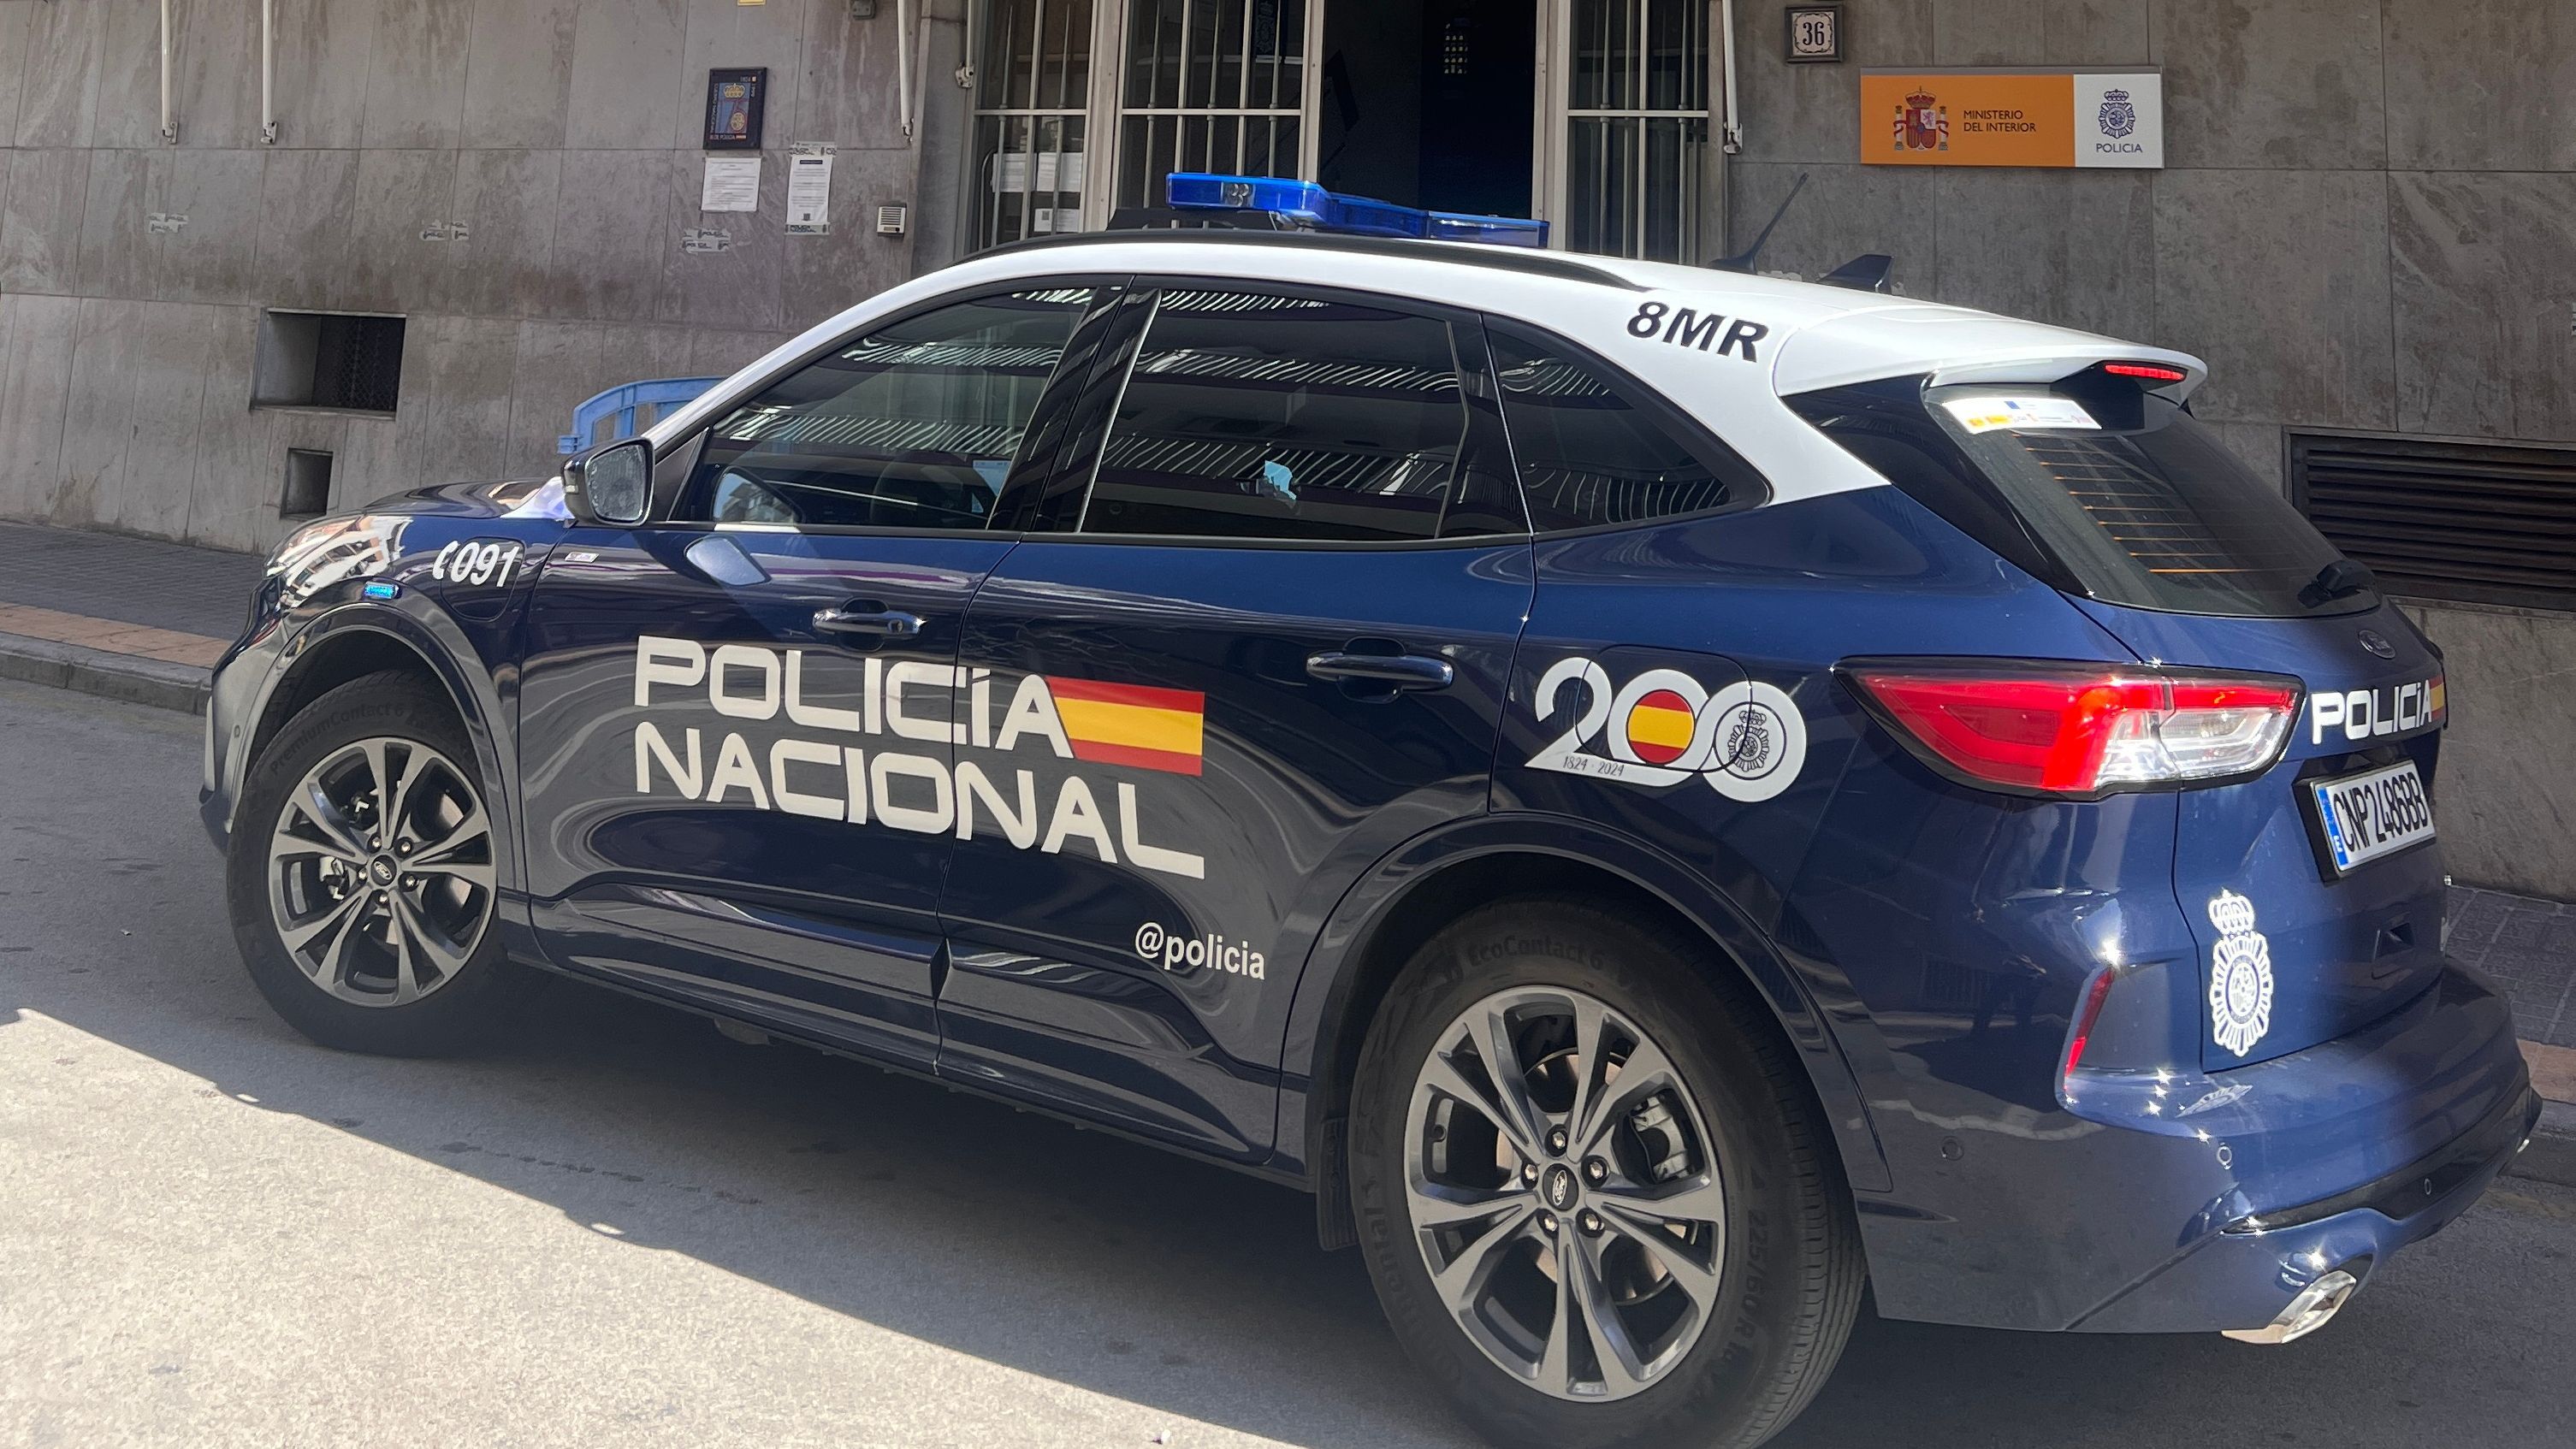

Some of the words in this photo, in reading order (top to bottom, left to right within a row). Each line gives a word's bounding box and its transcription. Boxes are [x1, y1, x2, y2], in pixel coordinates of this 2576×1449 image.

[1803, 21, 1824, 45] 36
[1963, 109, 2023, 120] MINISTERIO
[1963, 121, 1983, 132] DEL
[1986, 121, 2036, 133] INTERIOR
[2096, 143, 2143, 153] POLICIA
[1627, 301, 1769, 363] 8MR
[451, 541, 520, 588] 091
[634, 635, 1075, 759] POLICÍA
[1562, 755, 1588, 772] 1824
[1597, 760, 1626, 778] 2024
[634, 721, 1205, 879] NACIONAL
[1135, 921, 1265, 980] @policia
